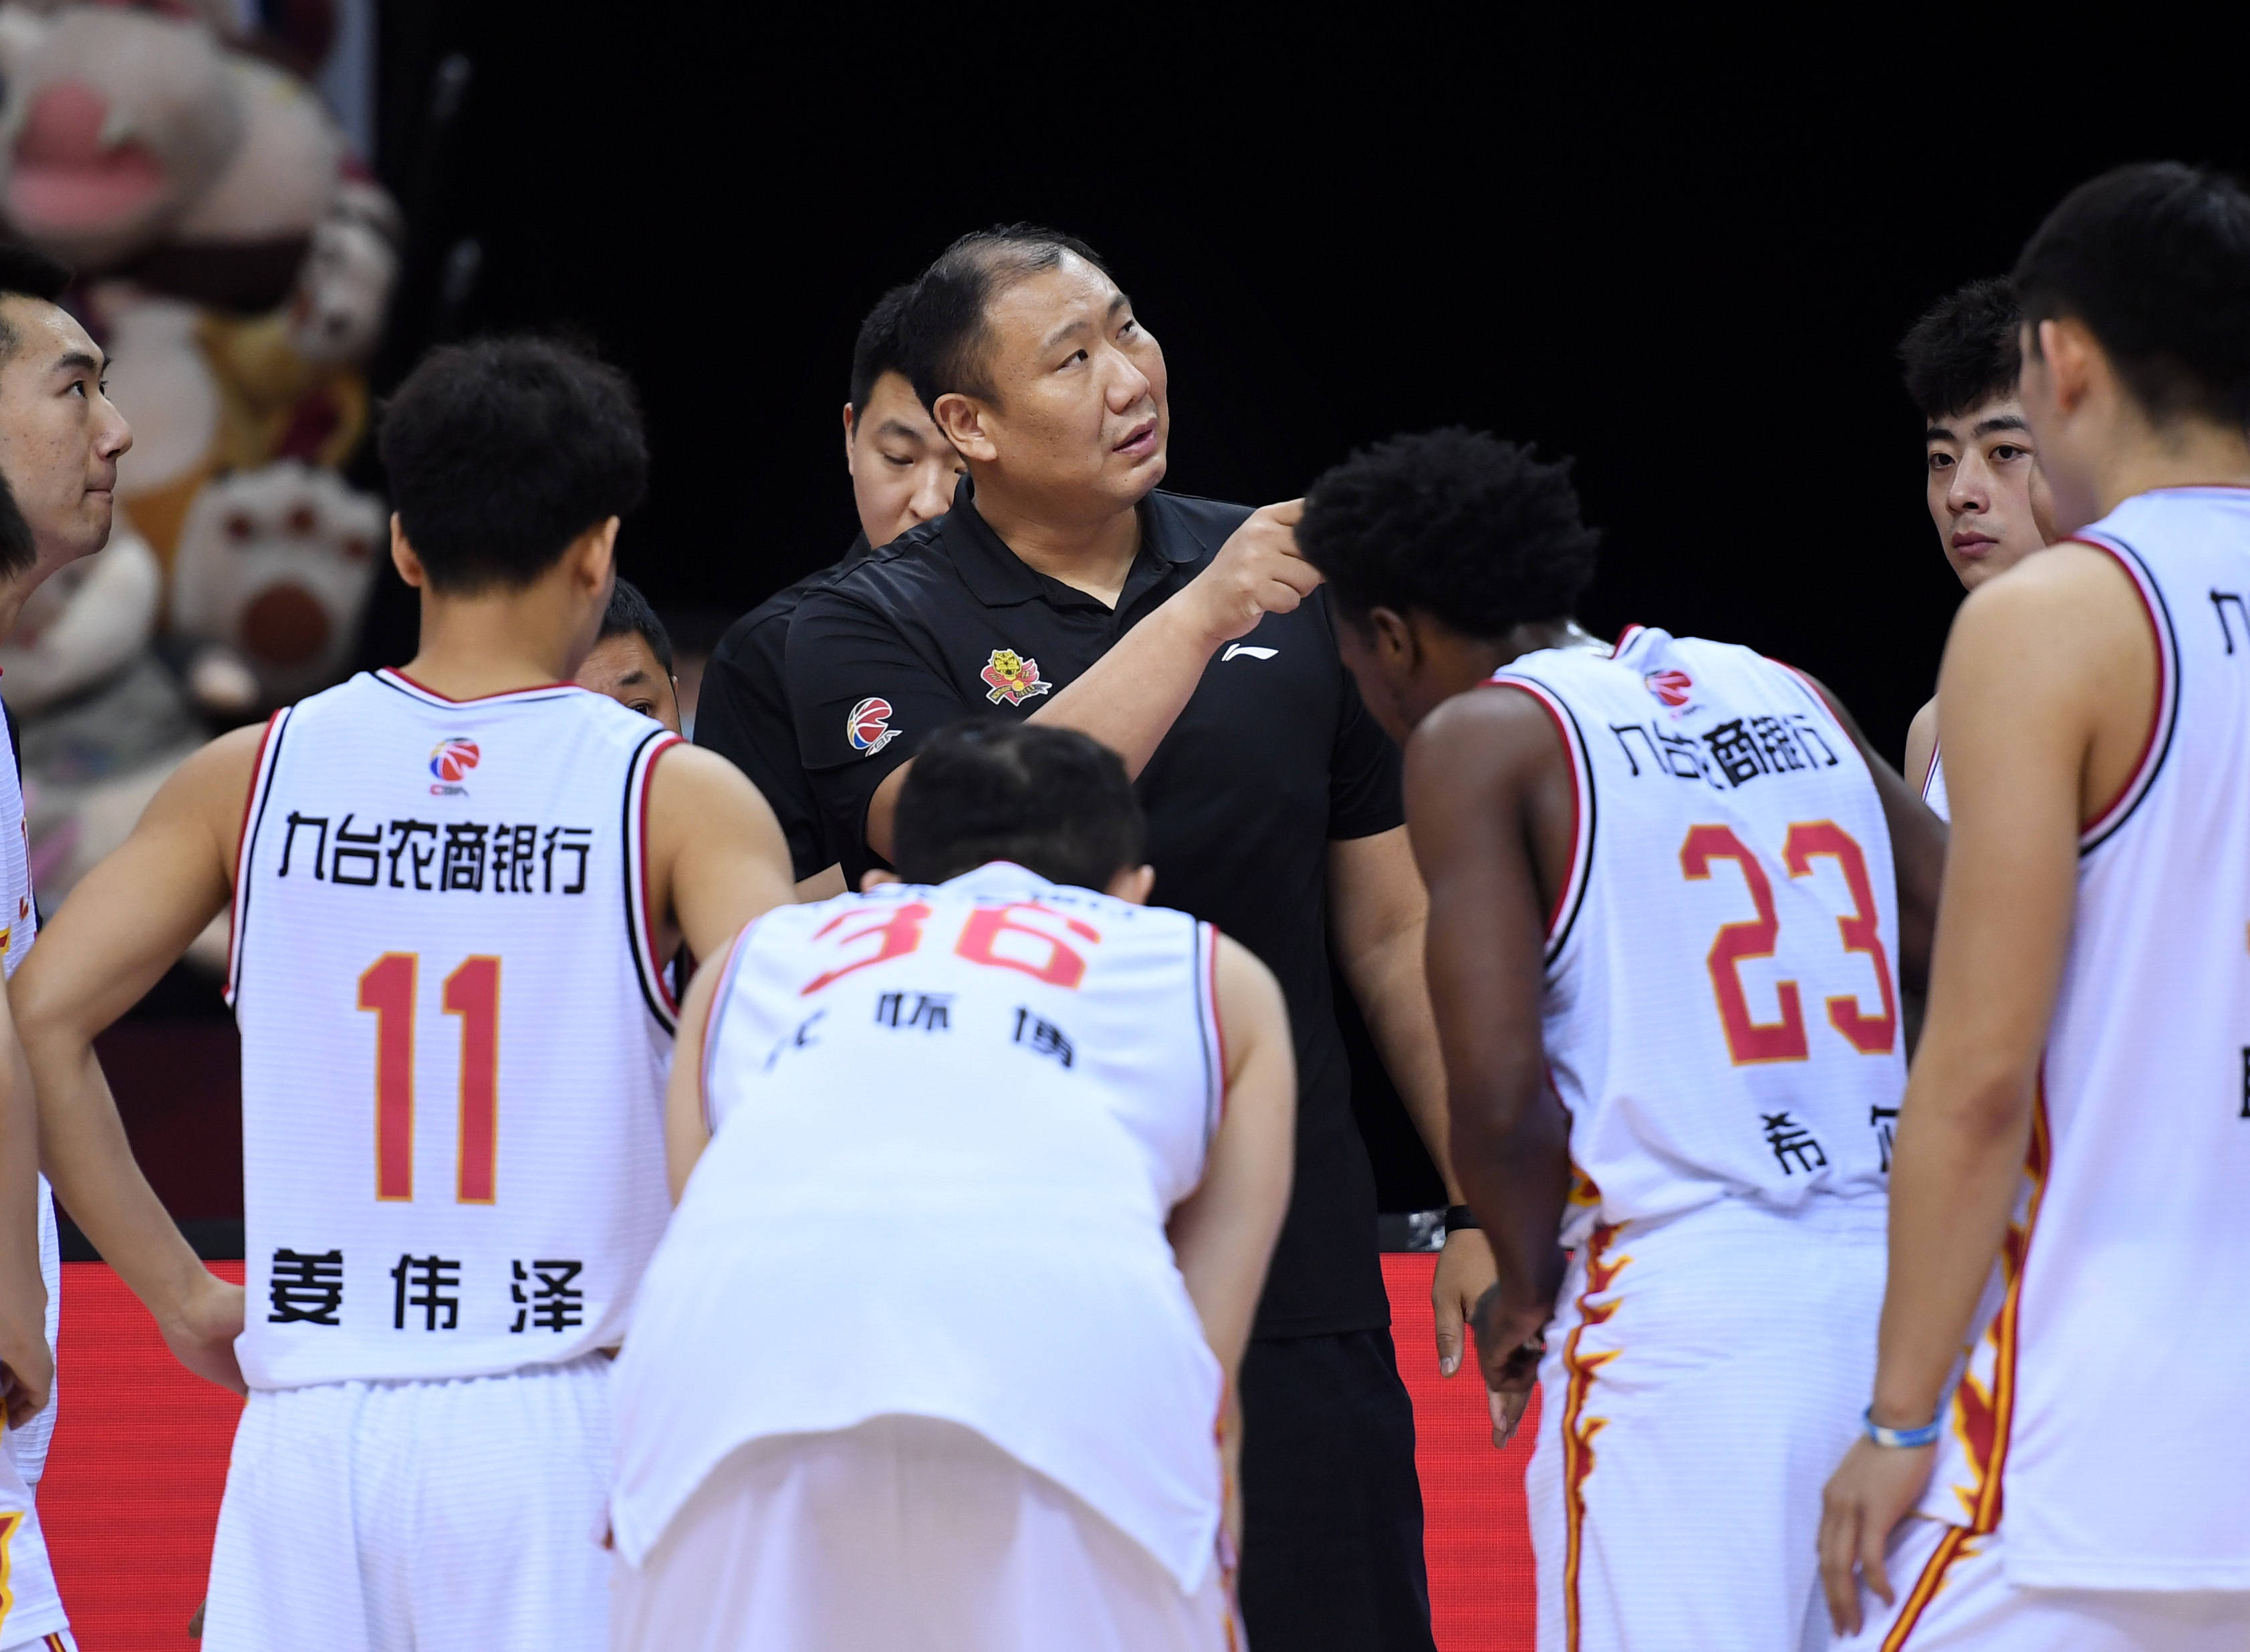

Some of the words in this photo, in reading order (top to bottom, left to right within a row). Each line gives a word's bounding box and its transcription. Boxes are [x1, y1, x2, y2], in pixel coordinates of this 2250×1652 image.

[1016, 686, 1035, 698] TIGERS
[865, 730, 903, 756] CBA
[278, 811, 592, 894] 九台农商银行
[800, 900, 1102, 996] 36
[1679, 819, 1897, 1067] 23
[357, 951, 501, 1205] 11
[267, 1248, 583, 1333] 姜伟泽
